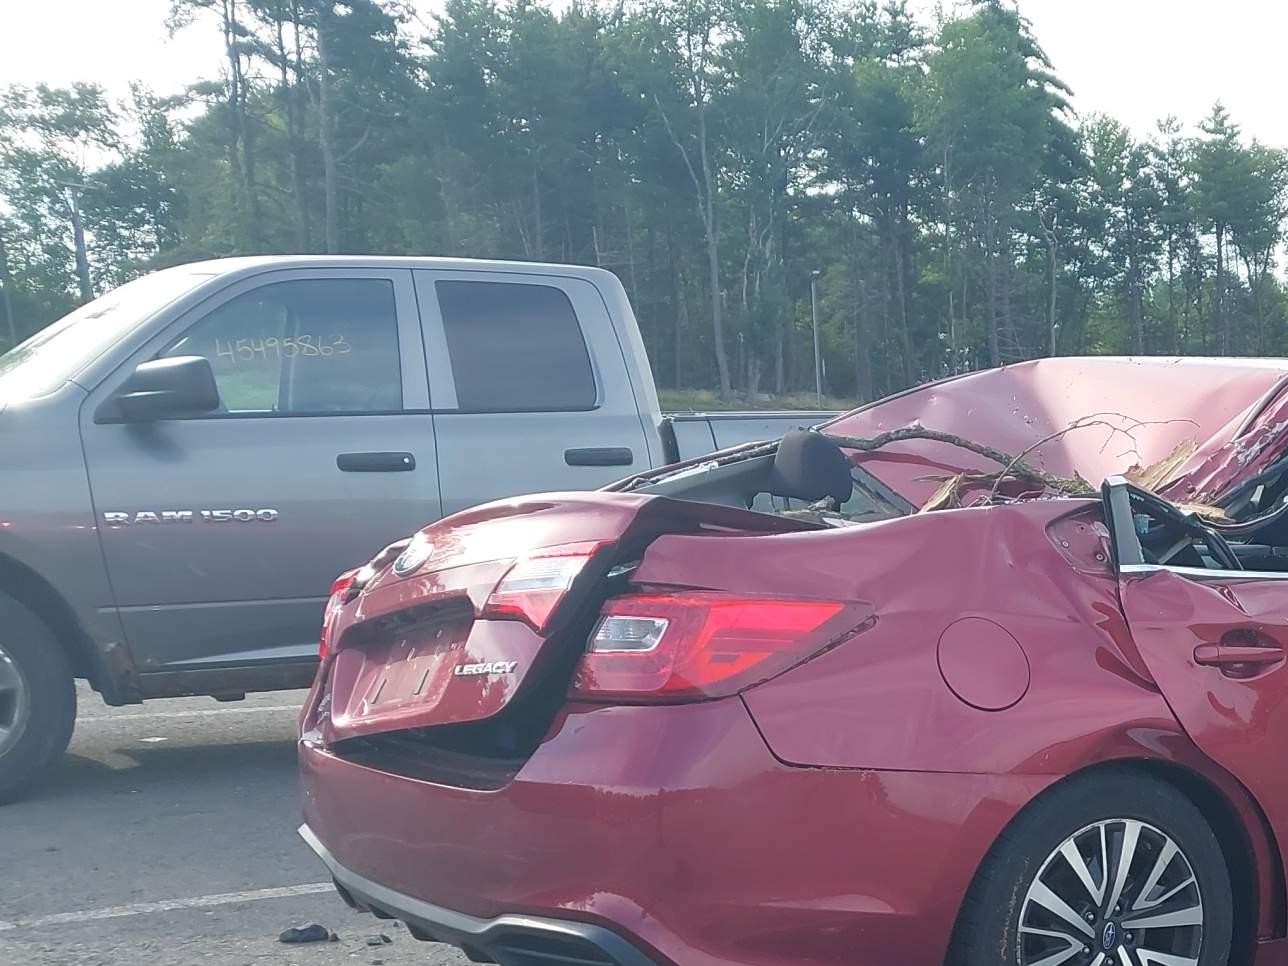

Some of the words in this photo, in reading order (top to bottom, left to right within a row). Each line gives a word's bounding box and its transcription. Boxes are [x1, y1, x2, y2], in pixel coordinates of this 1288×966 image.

[215, 335, 352, 363] 45495863
[103, 511, 193, 525] RAM
[200, 509, 279, 522] 1500
[454, 660, 518, 676] LEGACY
